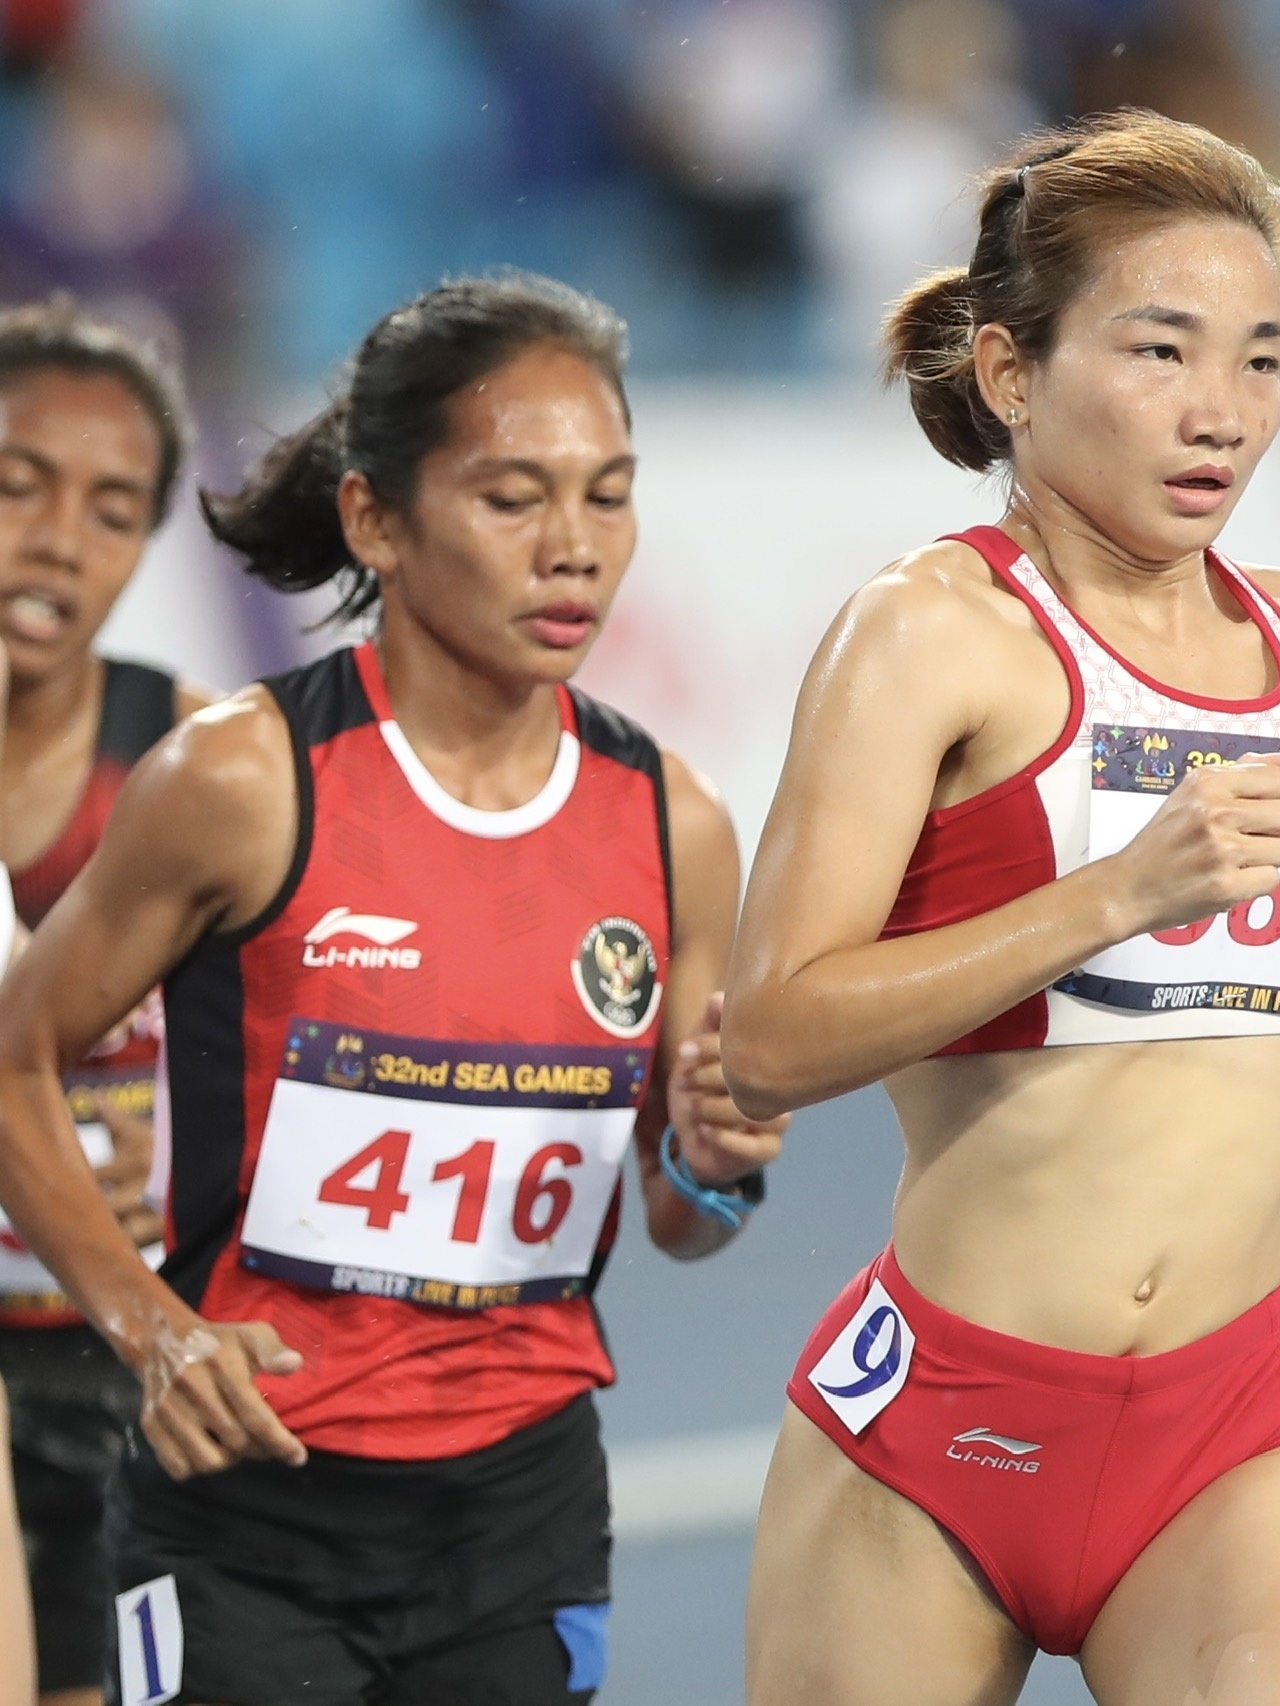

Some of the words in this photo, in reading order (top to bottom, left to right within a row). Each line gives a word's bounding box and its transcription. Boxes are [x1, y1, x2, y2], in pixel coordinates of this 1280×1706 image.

[302, 945, 422, 970] LI-NING
[1151, 985, 1208, 1008] SPORTS
[1212, 986, 1249, 1008] LIVE
[1252, 988, 1272, 1010] IN
[374, 1053, 450, 1088] 32nd
[453, 1061, 510, 1092] SEA
[513, 1064, 612, 1095] GAMES
[317, 1129, 583, 1244] 416
[817, 1305, 902, 1398] 9
[946, 1445, 1041, 1473] LI-NING
[132, 1591, 165, 1699] 1
